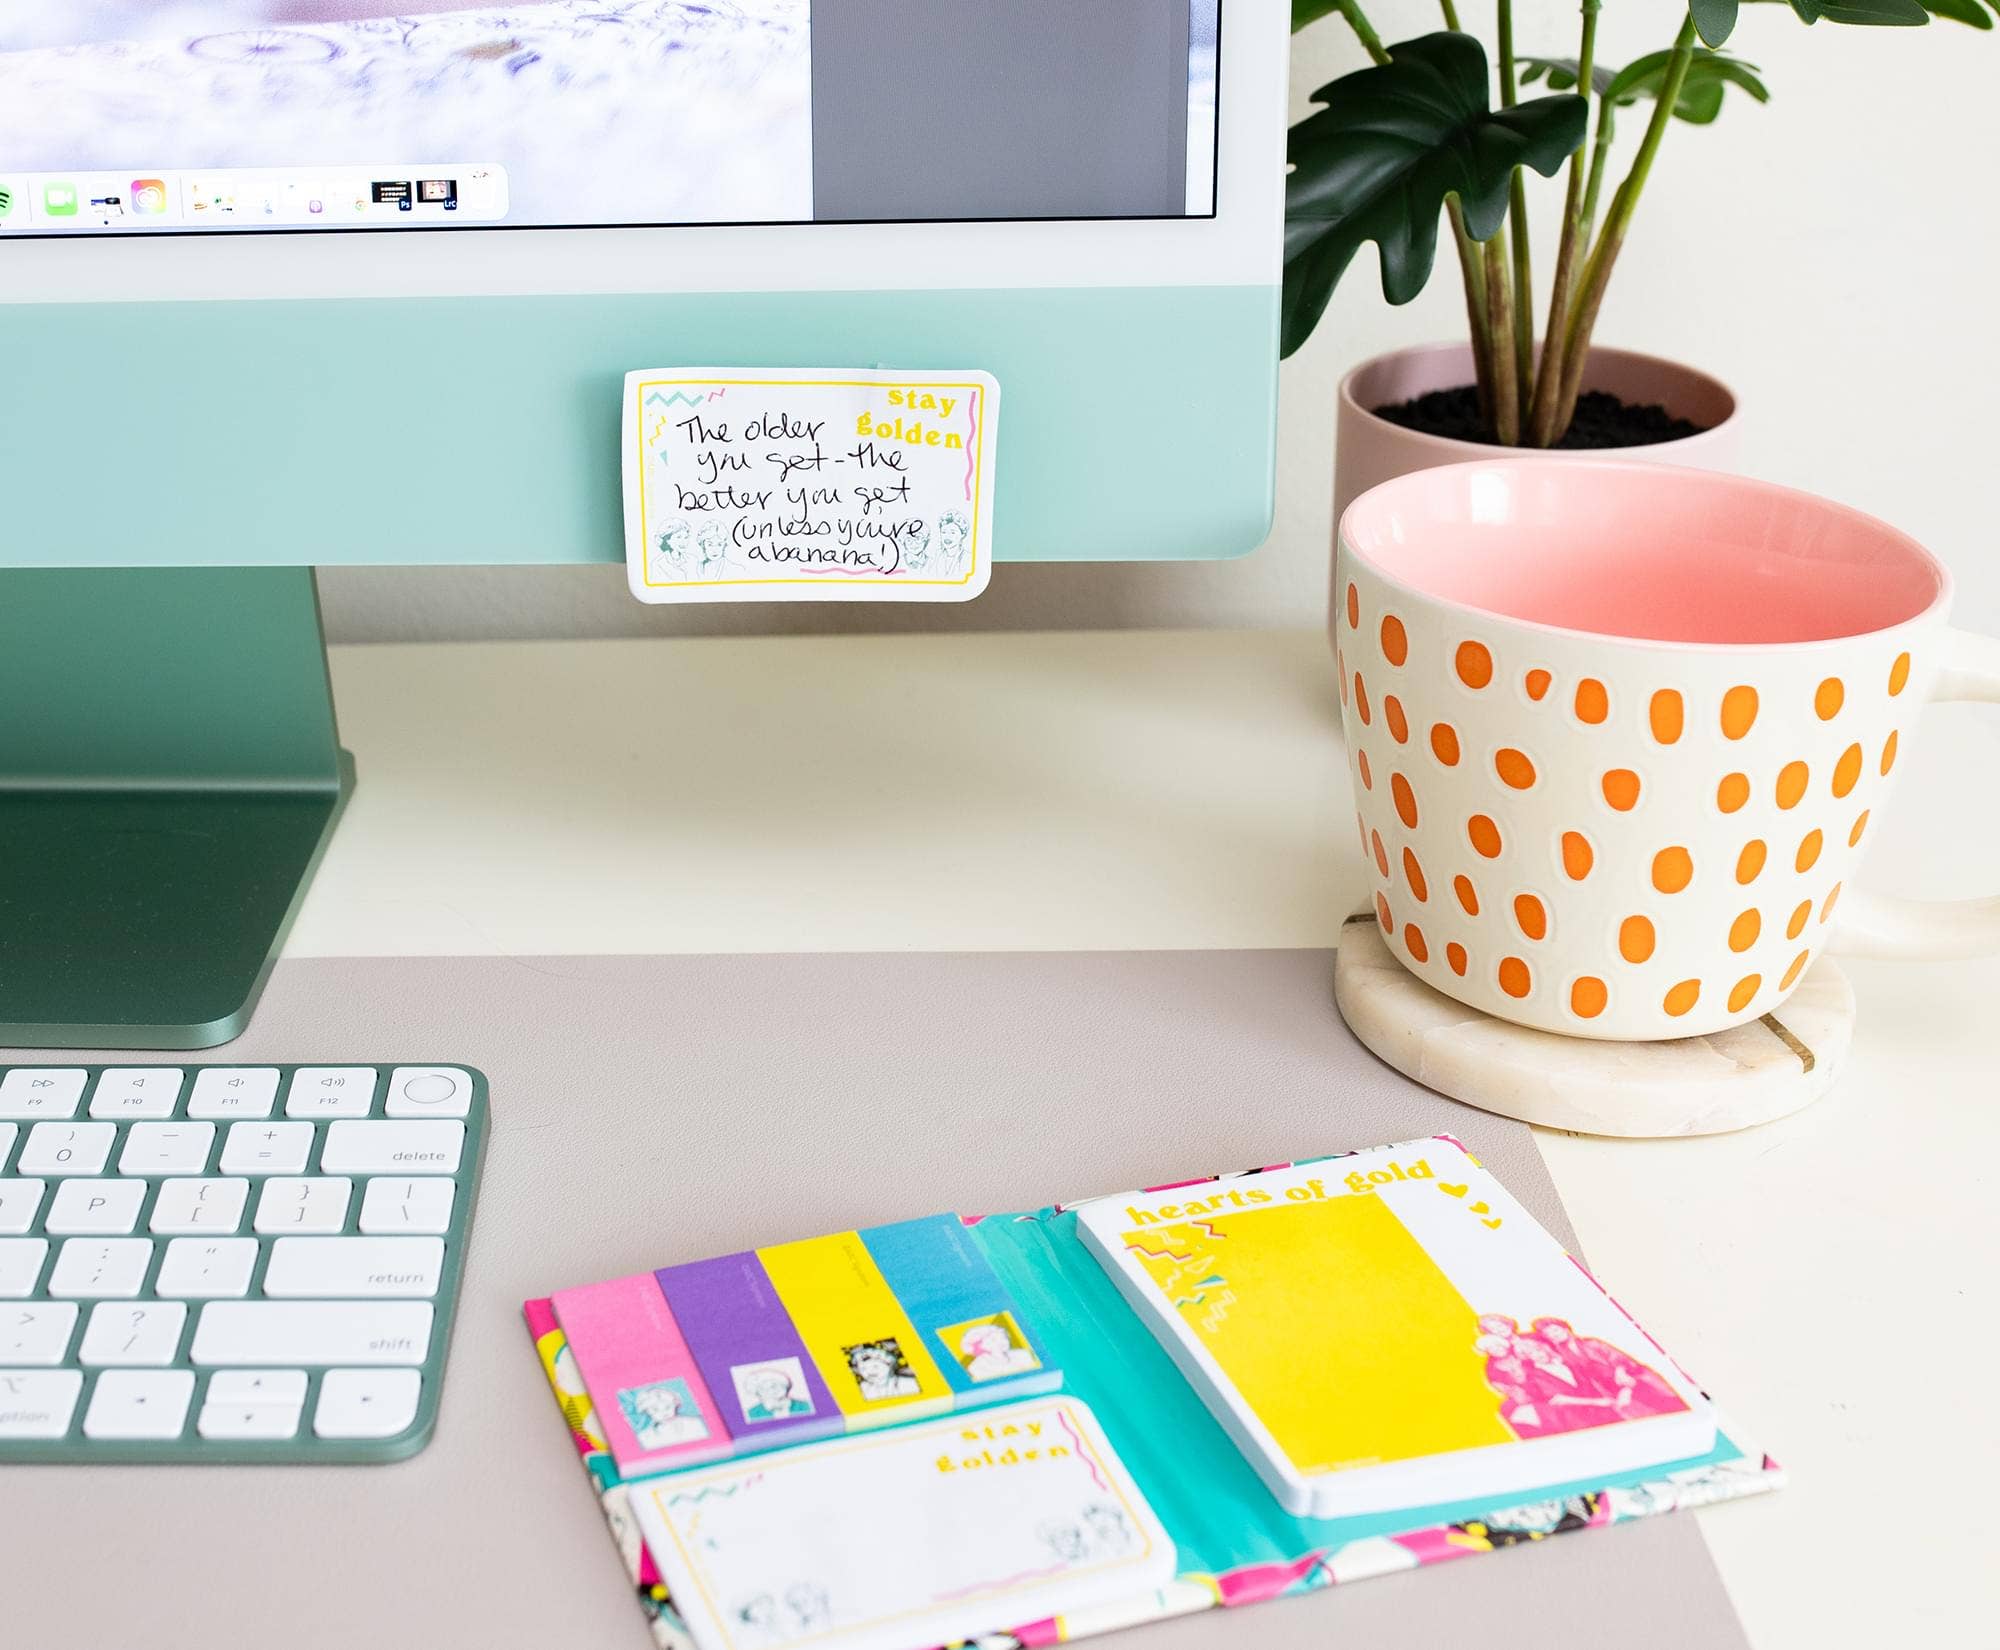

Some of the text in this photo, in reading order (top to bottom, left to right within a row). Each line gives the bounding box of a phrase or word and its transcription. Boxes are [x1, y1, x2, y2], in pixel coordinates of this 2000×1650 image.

[400, 201, 410, 209] Ps
[888, 389, 958, 418] stay
[676, 412, 825, 443] The older
[856, 411, 962, 449] golden
[674, 483, 773, 512] better
[786, 487, 842, 524] you
[854, 476, 911, 516] get
[732, 516, 831, 547] (unless
[27, 1097, 43, 1106] F9
[121, 1097, 145, 1106] F10
[221, 1097, 241, 1105] F11
[318, 1097, 340, 1105] F12
[391, 1151, 446, 1162] delete
[1125, 1158, 1436, 1226] hearts of gold
[88, 1197, 108, 1213] P
[367, 1273, 425, 1284] return
[369, 1338, 412, 1350] shift
[0, 1409, 50, 1423] ption
[961, 1422, 1041, 1441] stay
[936, 1447, 1068, 1472] golden
